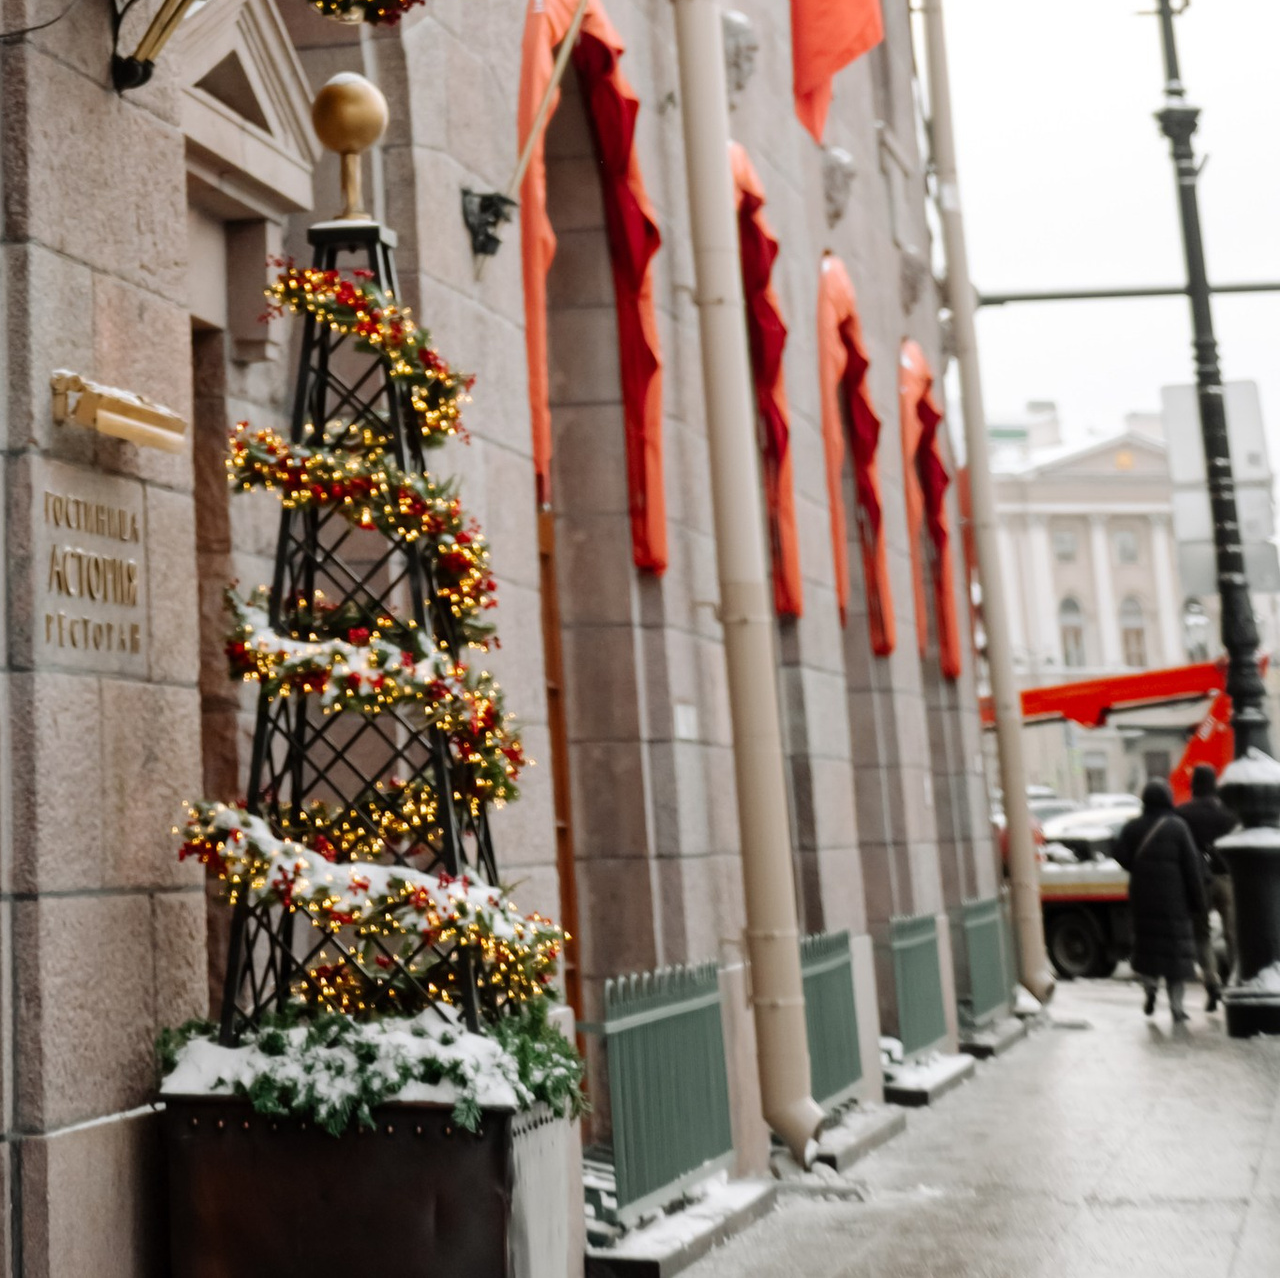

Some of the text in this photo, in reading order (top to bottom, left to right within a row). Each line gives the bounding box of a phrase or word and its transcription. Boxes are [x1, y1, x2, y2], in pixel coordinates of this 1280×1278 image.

[44, 491, 140, 543] ГОСТИНИЦА
[48, 544, 138, 607] АСТОРИЯ
[44, 612, 141, 654] РЕСТОРАН
